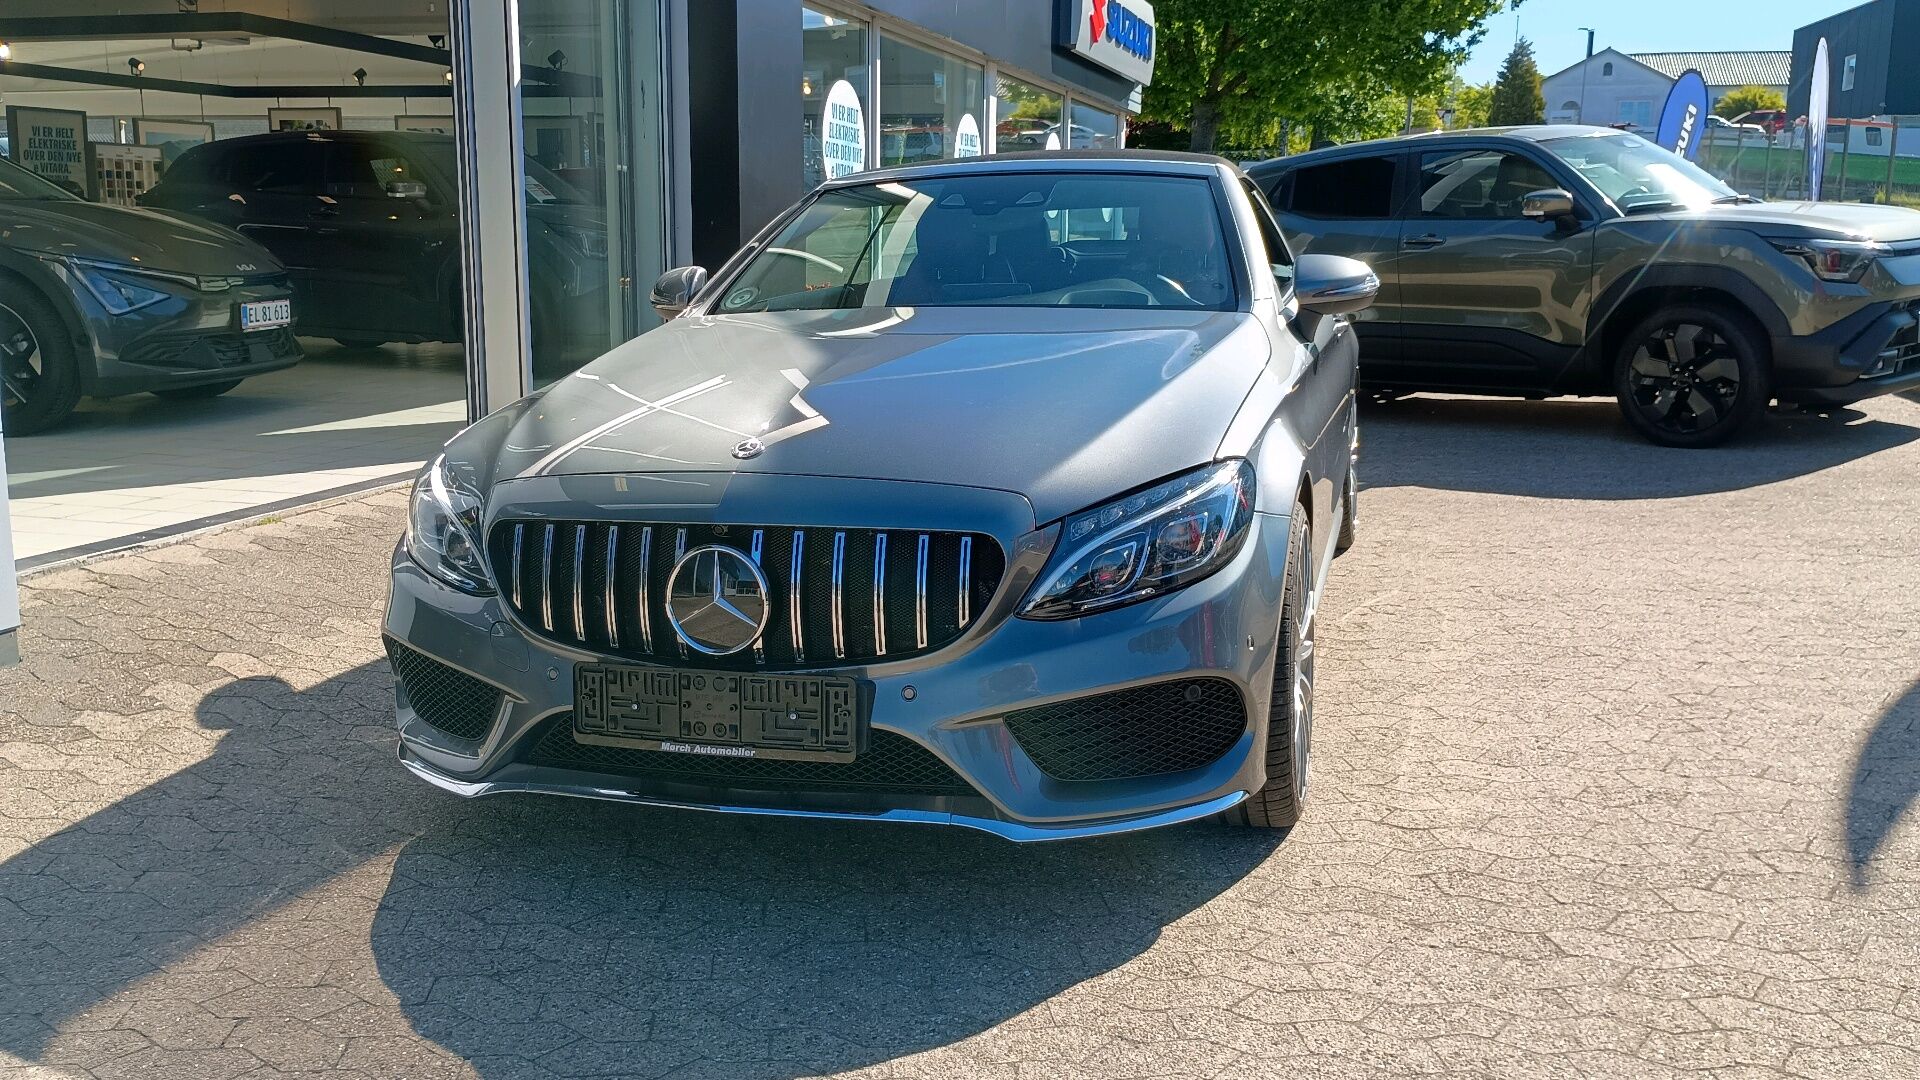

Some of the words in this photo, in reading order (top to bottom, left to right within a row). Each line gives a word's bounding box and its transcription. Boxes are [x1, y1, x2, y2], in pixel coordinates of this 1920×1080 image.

[1106, 0, 1153, 62] SUZUKI
[832, 102, 838, 119] VI
[839, 104, 846, 121] ER
[847, 106, 859, 125] HELT
[32, 126, 40, 137] VI
[43, 126, 53, 138] ER
[55, 127, 74, 139] HELT
[829, 121, 860, 144] ELEKTRISKE
[28, 138, 77, 151] ELEKTRISKE
[825, 141, 840, 159] OVER
[840, 144, 852, 162] DEN
[23, 149, 46, 161] OVER
[47, 150, 64, 162] DEN
[66, 151, 82, 163] NYE
[248, 307, 260, 323] EL
[262, 306, 272, 322] 81
[274, 304, 289, 320] 613
[693, 744, 756, 757] Automobiler
